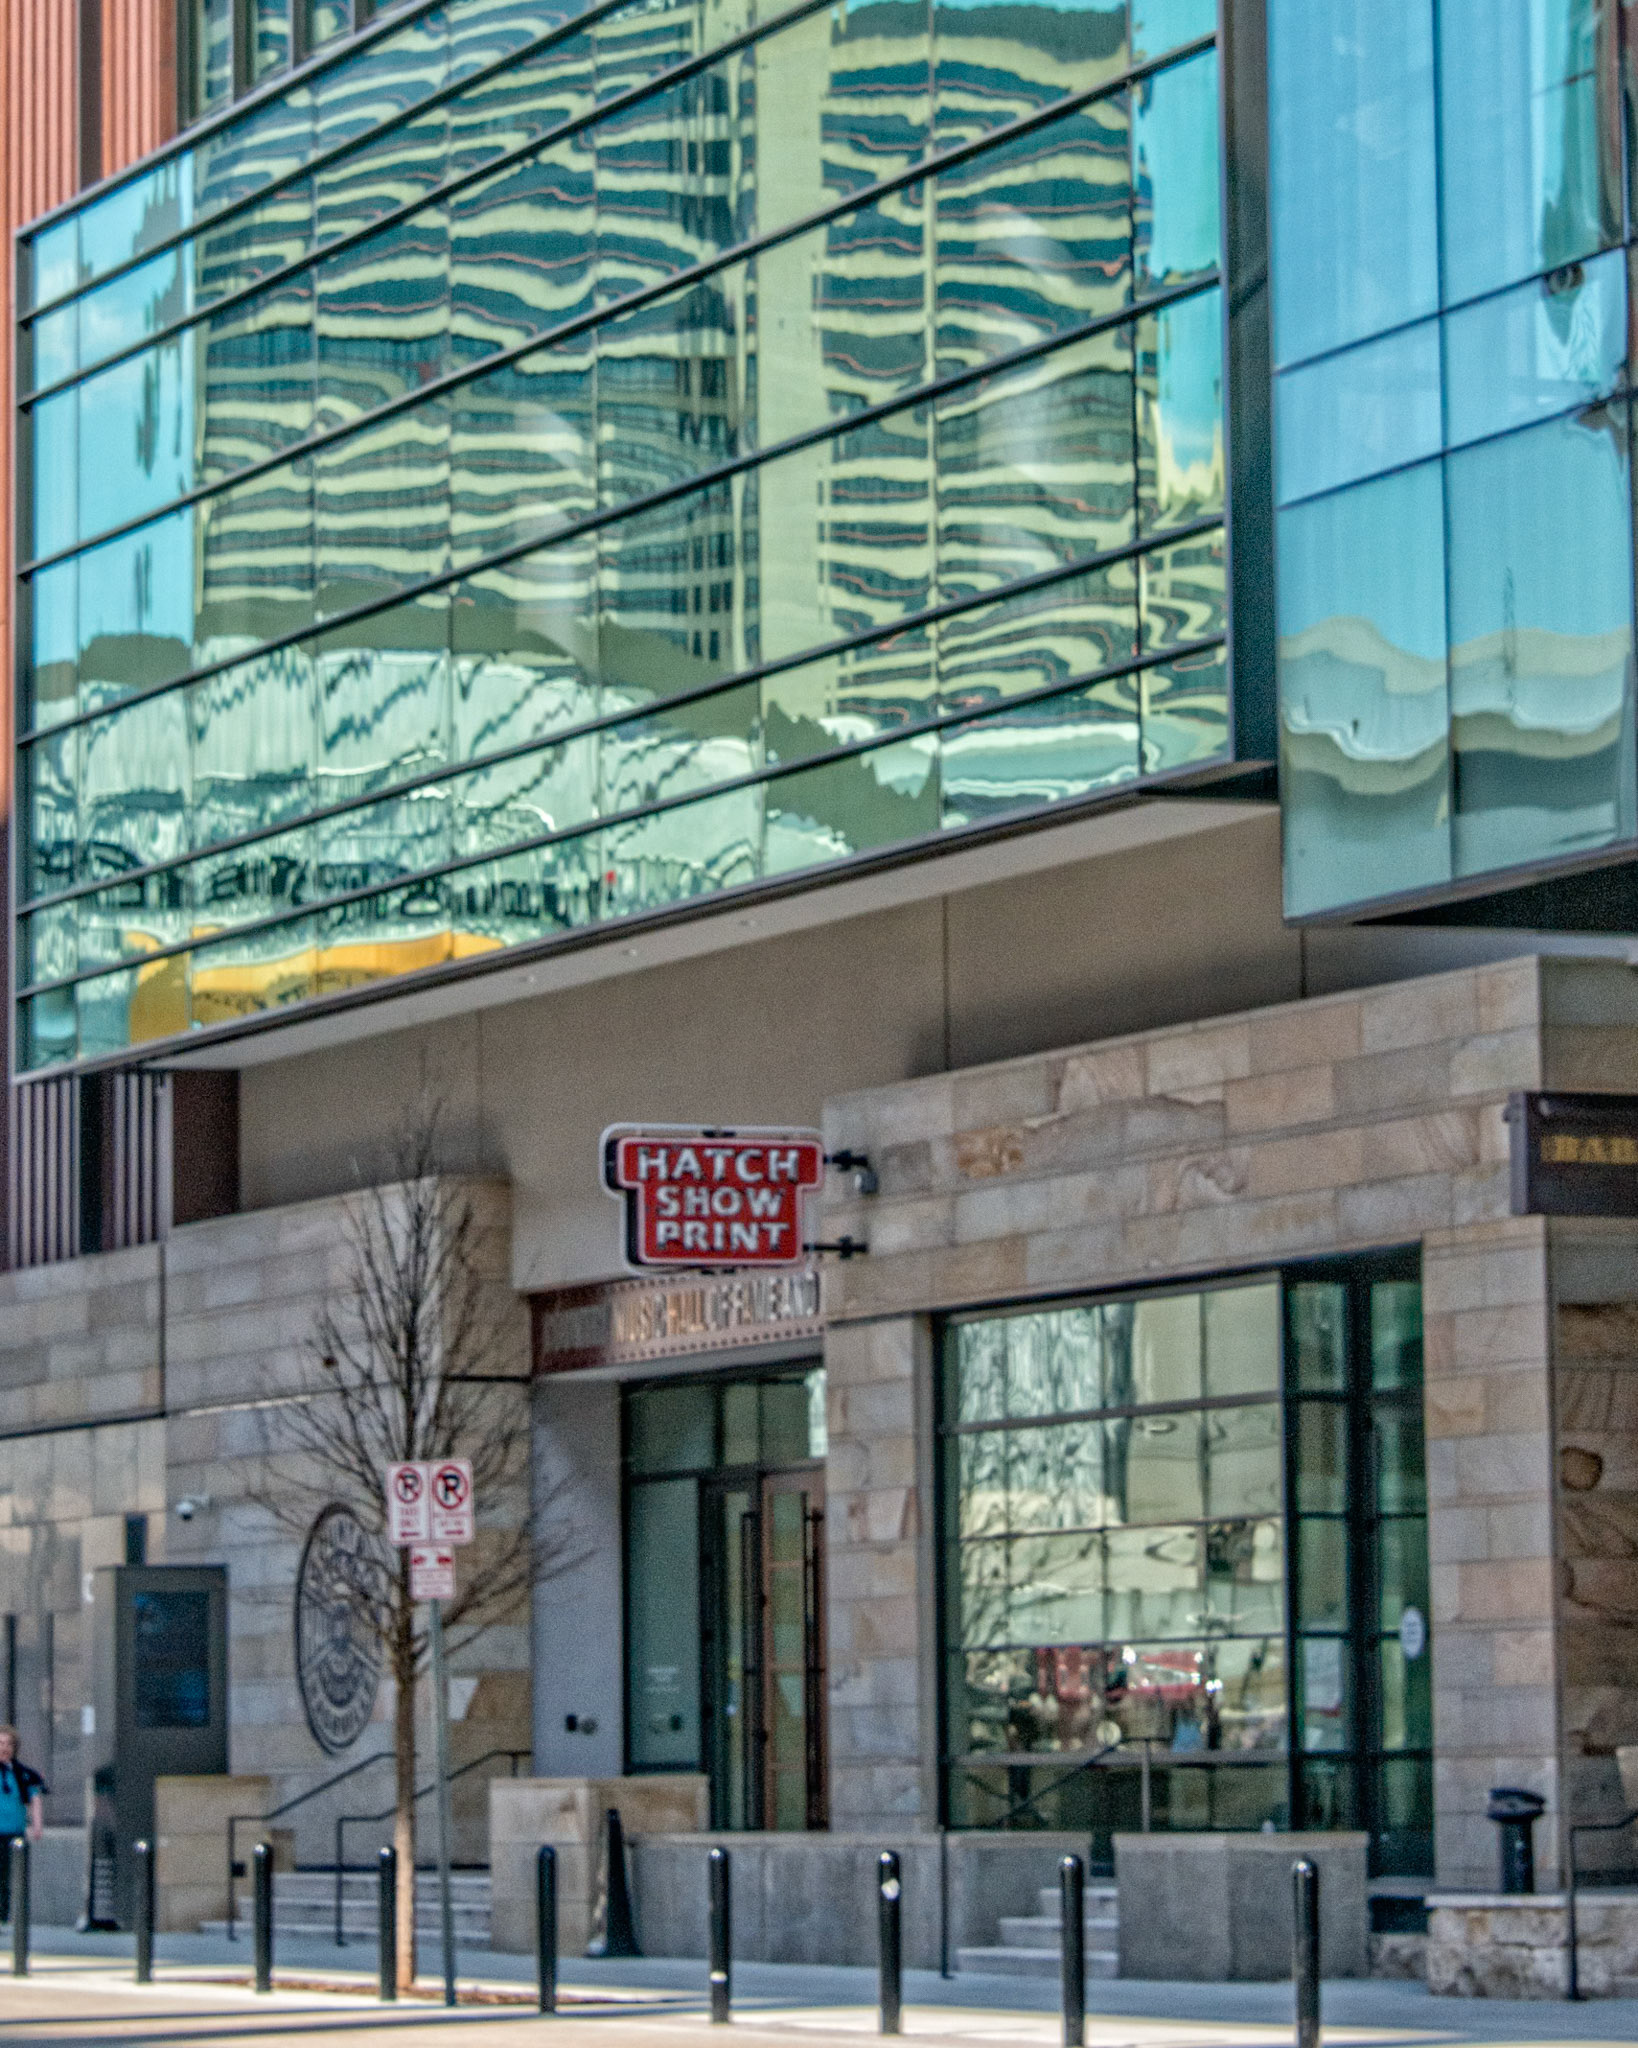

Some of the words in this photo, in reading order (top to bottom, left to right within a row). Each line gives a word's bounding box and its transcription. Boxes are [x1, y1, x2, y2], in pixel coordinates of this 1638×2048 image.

[636, 1147, 800, 1183] HATCH
[655, 1184, 784, 1218] SHOW
[655, 1220, 790, 1252] PRINT
